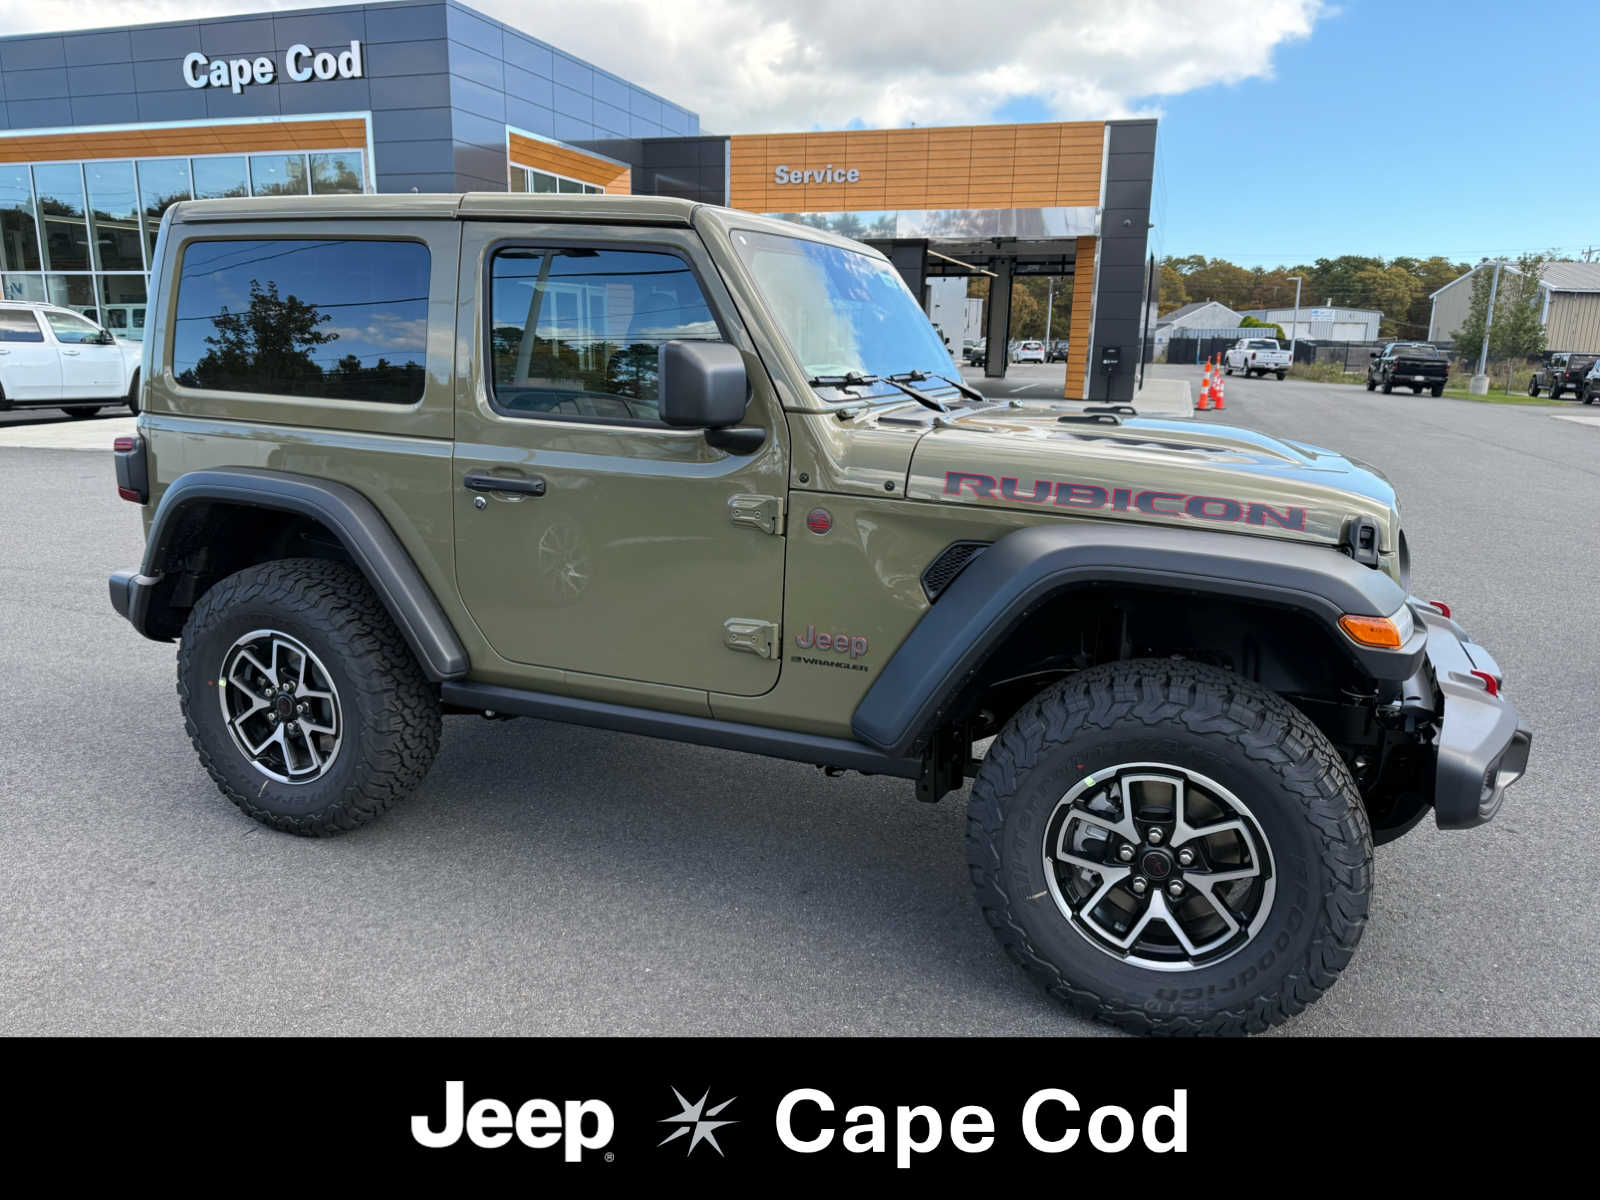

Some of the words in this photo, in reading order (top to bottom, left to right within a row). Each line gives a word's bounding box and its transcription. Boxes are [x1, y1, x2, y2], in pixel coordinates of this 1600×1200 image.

[183, 52, 275, 94] Cape
[286, 40, 363, 82] Cod
[775, 164, 860, 185] Service
[944, 471, 1308, 532] RUBICON
[796, 625, 869, 659] Jeep
[802, 656, 869, 672] WRANGLER
